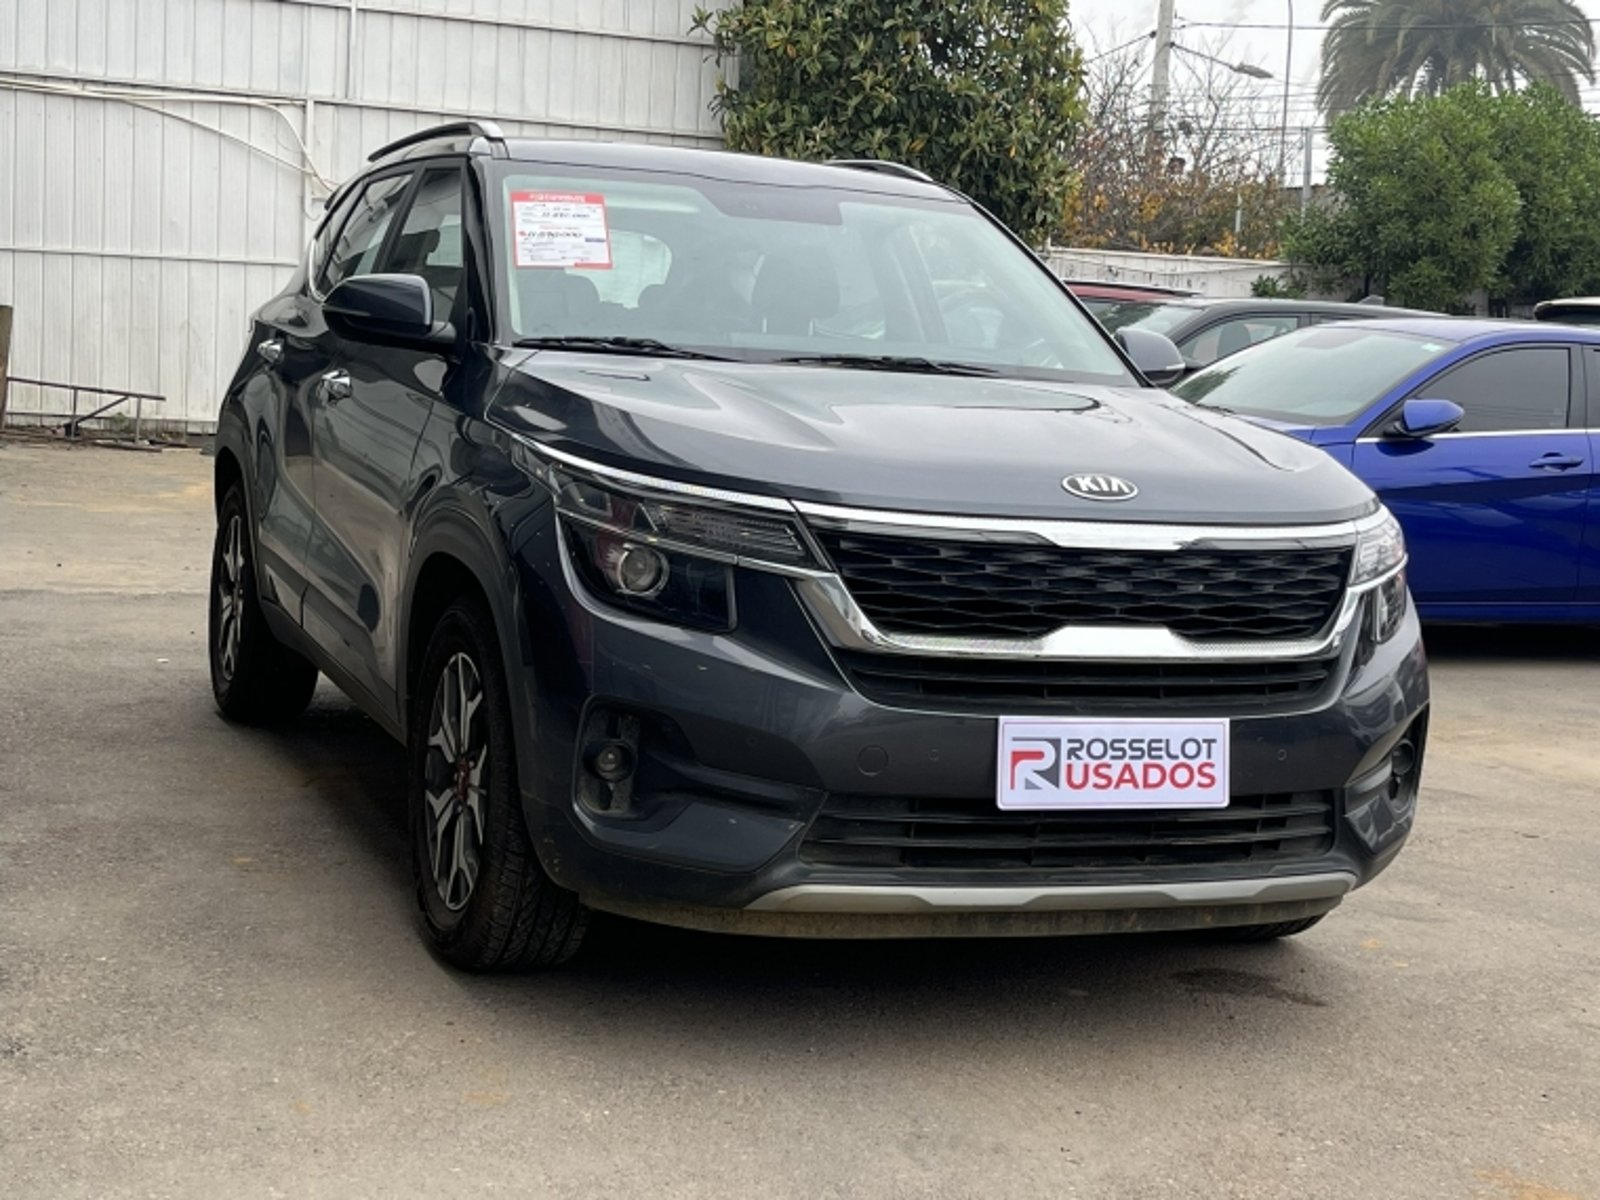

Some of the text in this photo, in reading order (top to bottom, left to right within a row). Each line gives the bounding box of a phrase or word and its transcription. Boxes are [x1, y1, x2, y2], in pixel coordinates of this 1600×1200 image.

[1075, 476, 1131, 494] KIA
[1066, 738, 1217, 761] ROSSELOT
[1066, 762, 1217, 790] USADOS
